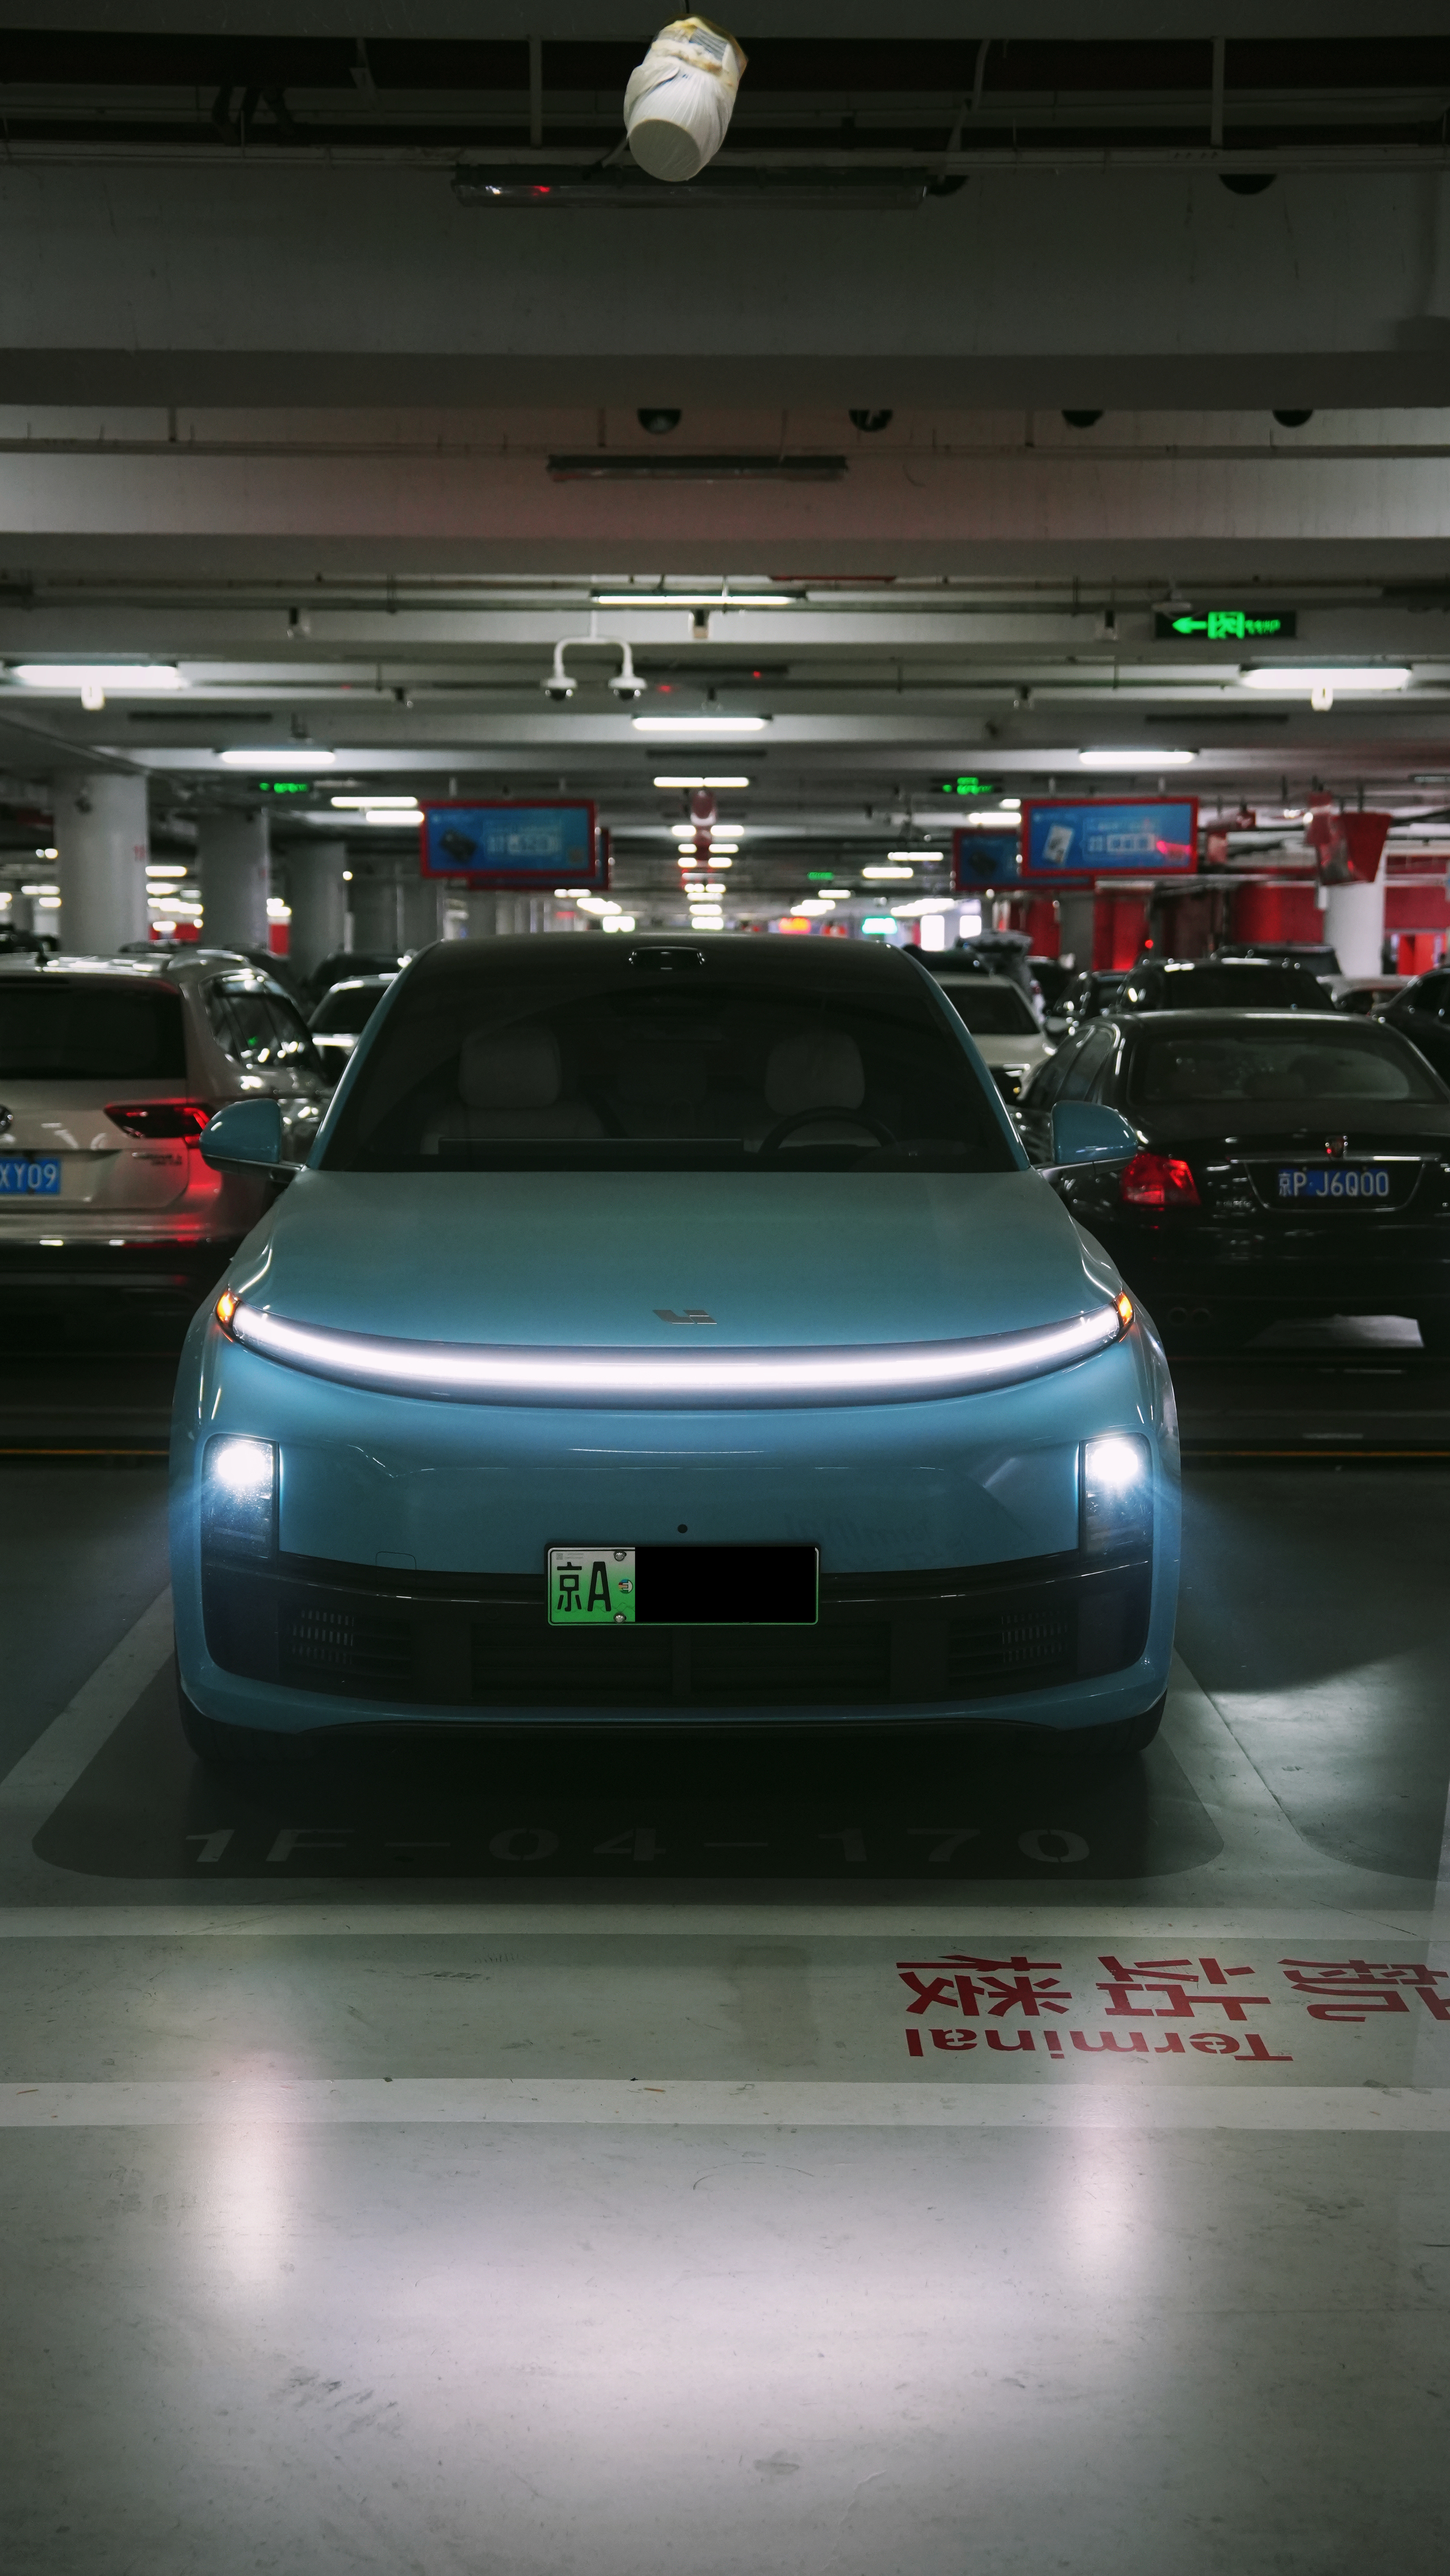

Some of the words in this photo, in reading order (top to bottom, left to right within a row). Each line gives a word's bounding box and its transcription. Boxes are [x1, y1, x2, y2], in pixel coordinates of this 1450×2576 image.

[557, 1561, 611, 1612] 京A
[896, 1955, 1450, 2022] 航站楼
[906, 2028, 1293, 2061] Terminal
